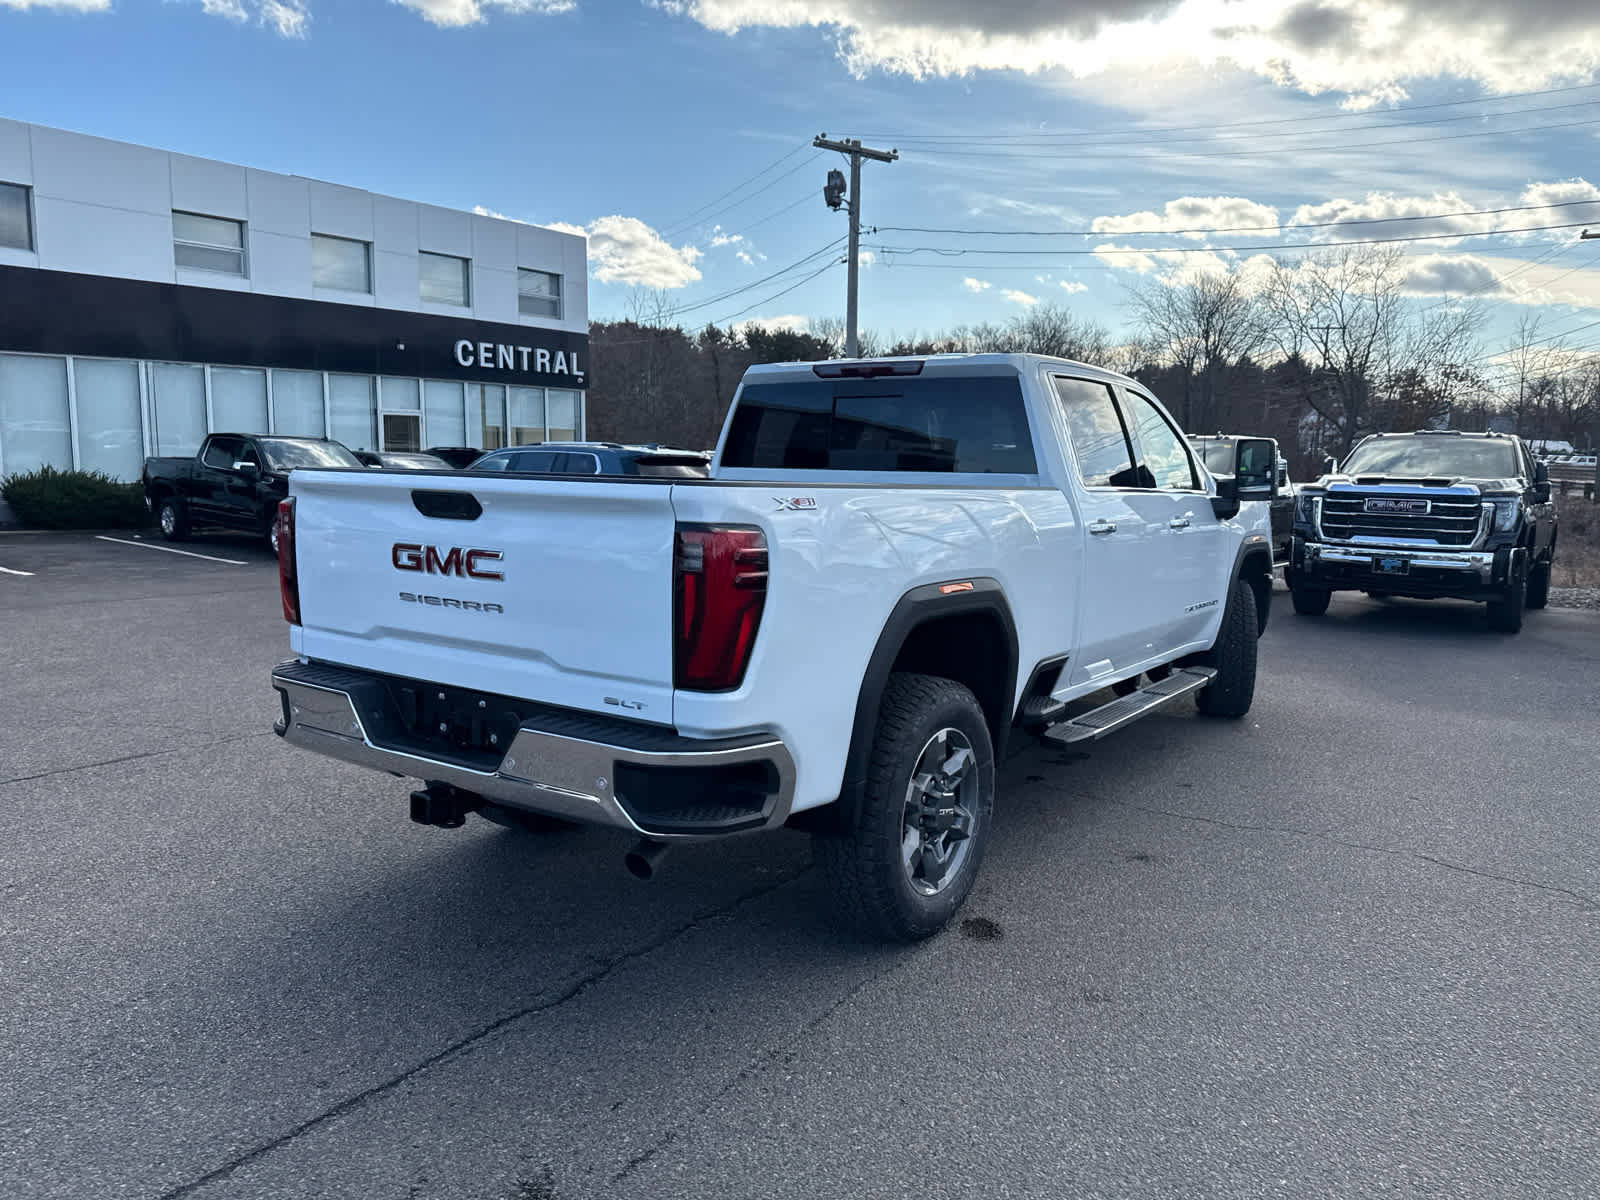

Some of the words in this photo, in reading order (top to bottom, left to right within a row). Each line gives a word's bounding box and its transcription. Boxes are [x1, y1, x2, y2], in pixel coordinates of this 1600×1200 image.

[454, 339, 585, 376] CENTRAL
[1367, 500, 1426, 513] GMC
[392, 543, 504, 581] GMC
[400, 592, 504, 614] SIERRA
[604, 696, 648, 710] SLT
